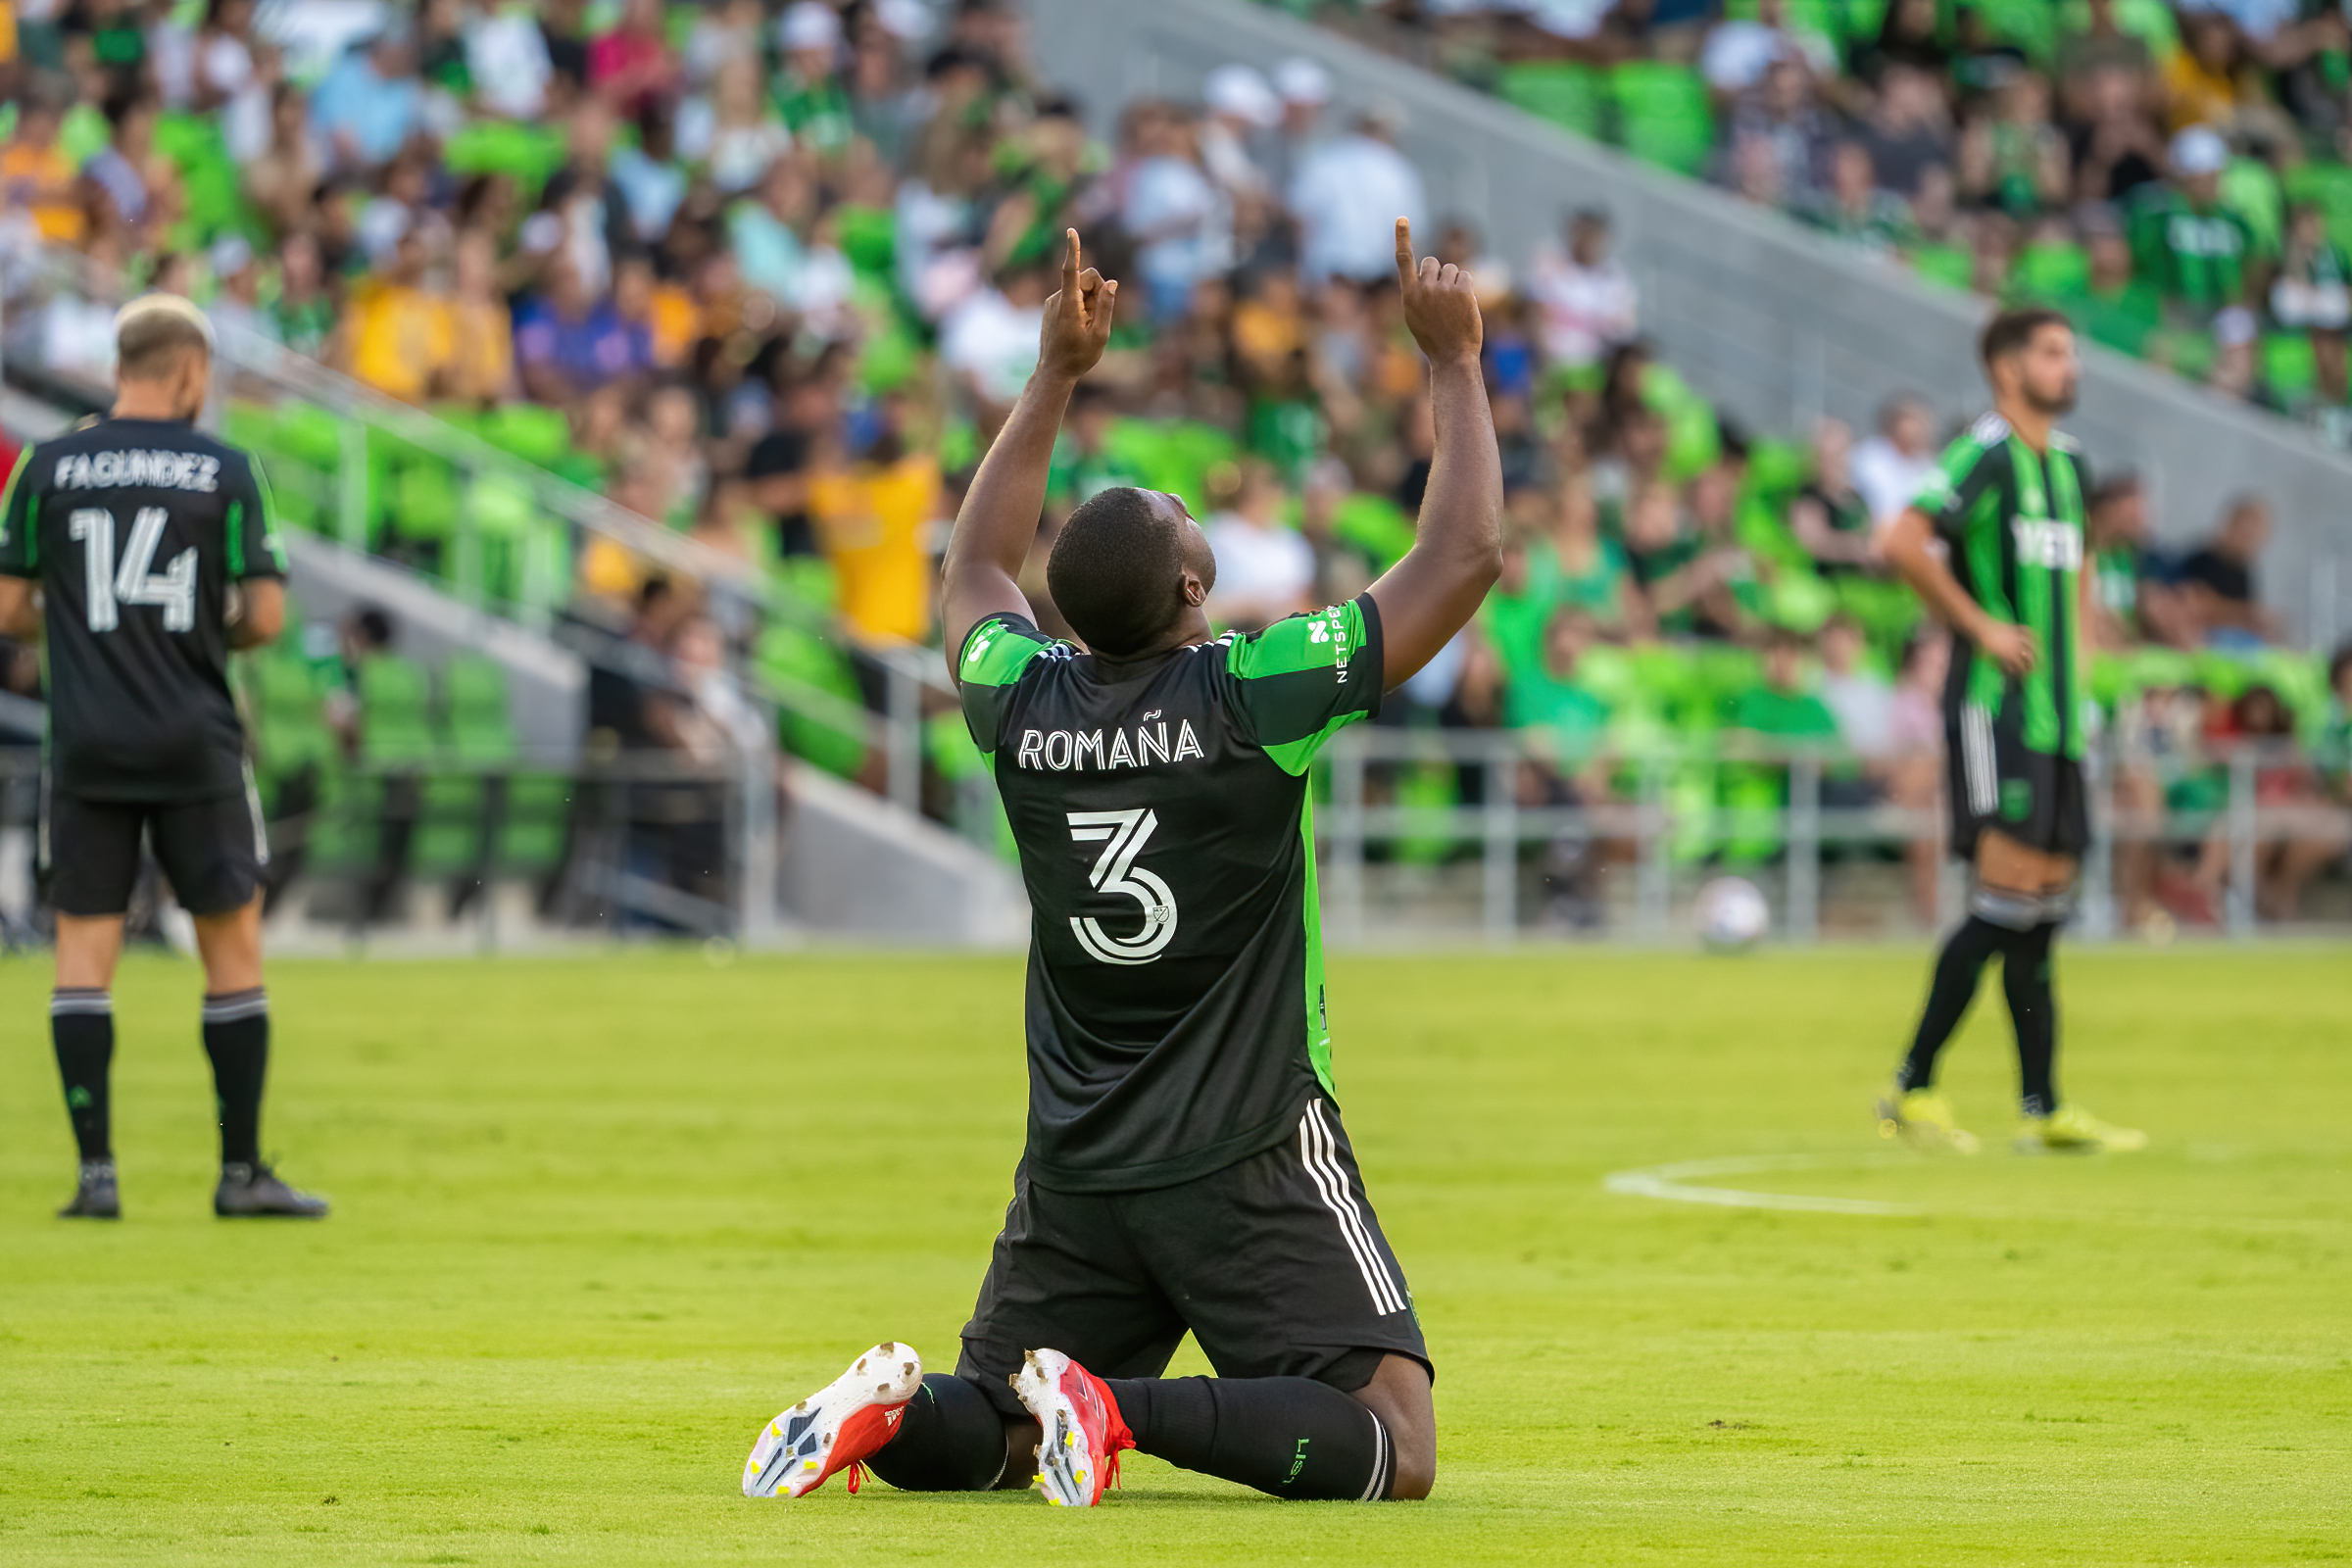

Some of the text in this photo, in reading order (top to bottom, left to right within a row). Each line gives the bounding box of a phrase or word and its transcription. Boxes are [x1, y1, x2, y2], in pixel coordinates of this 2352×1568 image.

[69, 506, 199, 633] 14
[1017, 709, 1205, 772] ROMAÑA
[1066, 808, 1178, 965] 3
